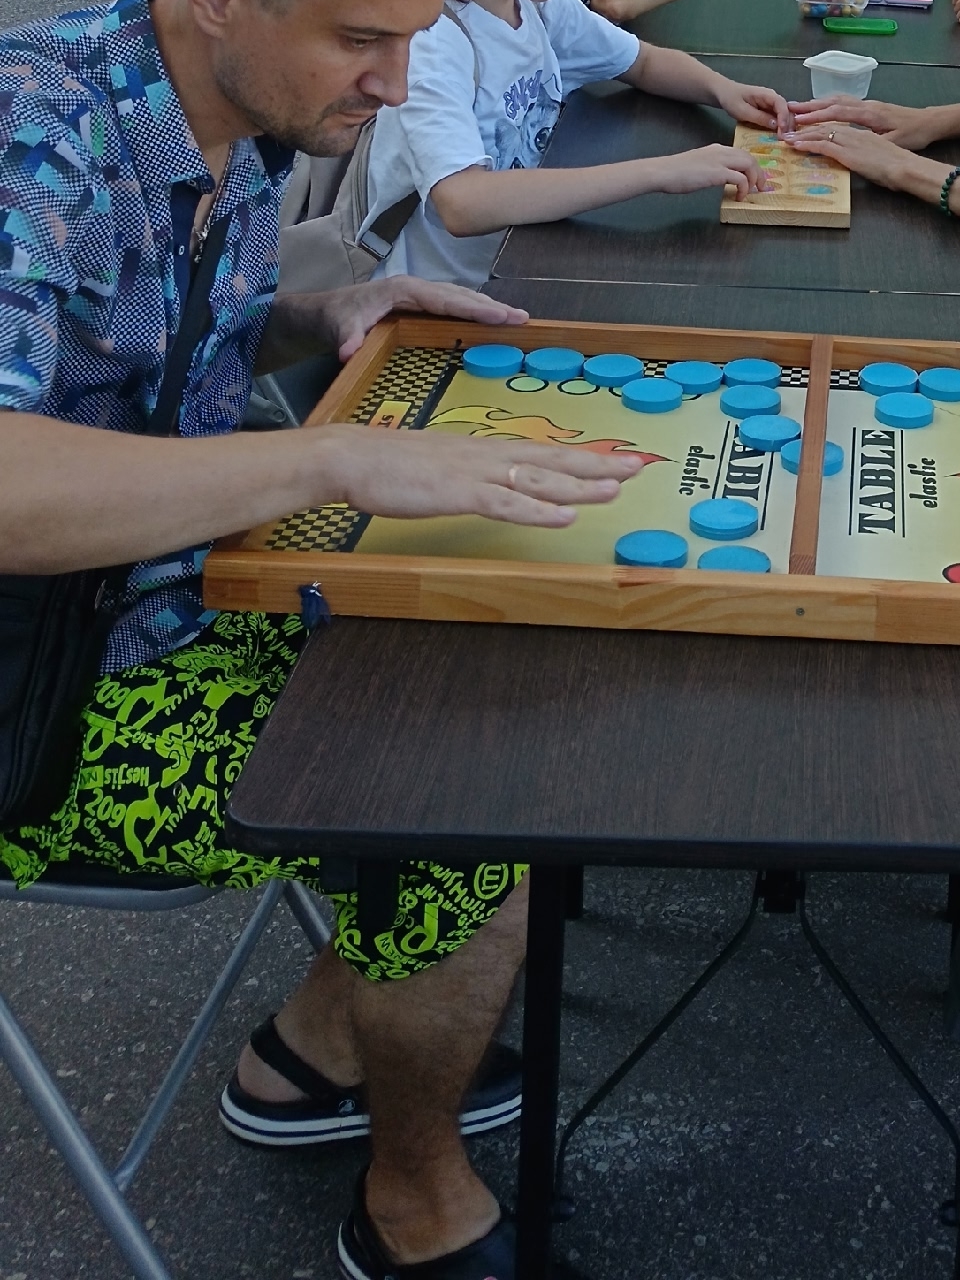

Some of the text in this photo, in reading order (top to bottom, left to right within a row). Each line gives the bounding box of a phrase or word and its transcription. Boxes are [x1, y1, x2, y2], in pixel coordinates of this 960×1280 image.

[679, 445, 716, 496] elastic
[858, 430, 895, 534] TABLE
[907, 457, 938, 508] elastic
